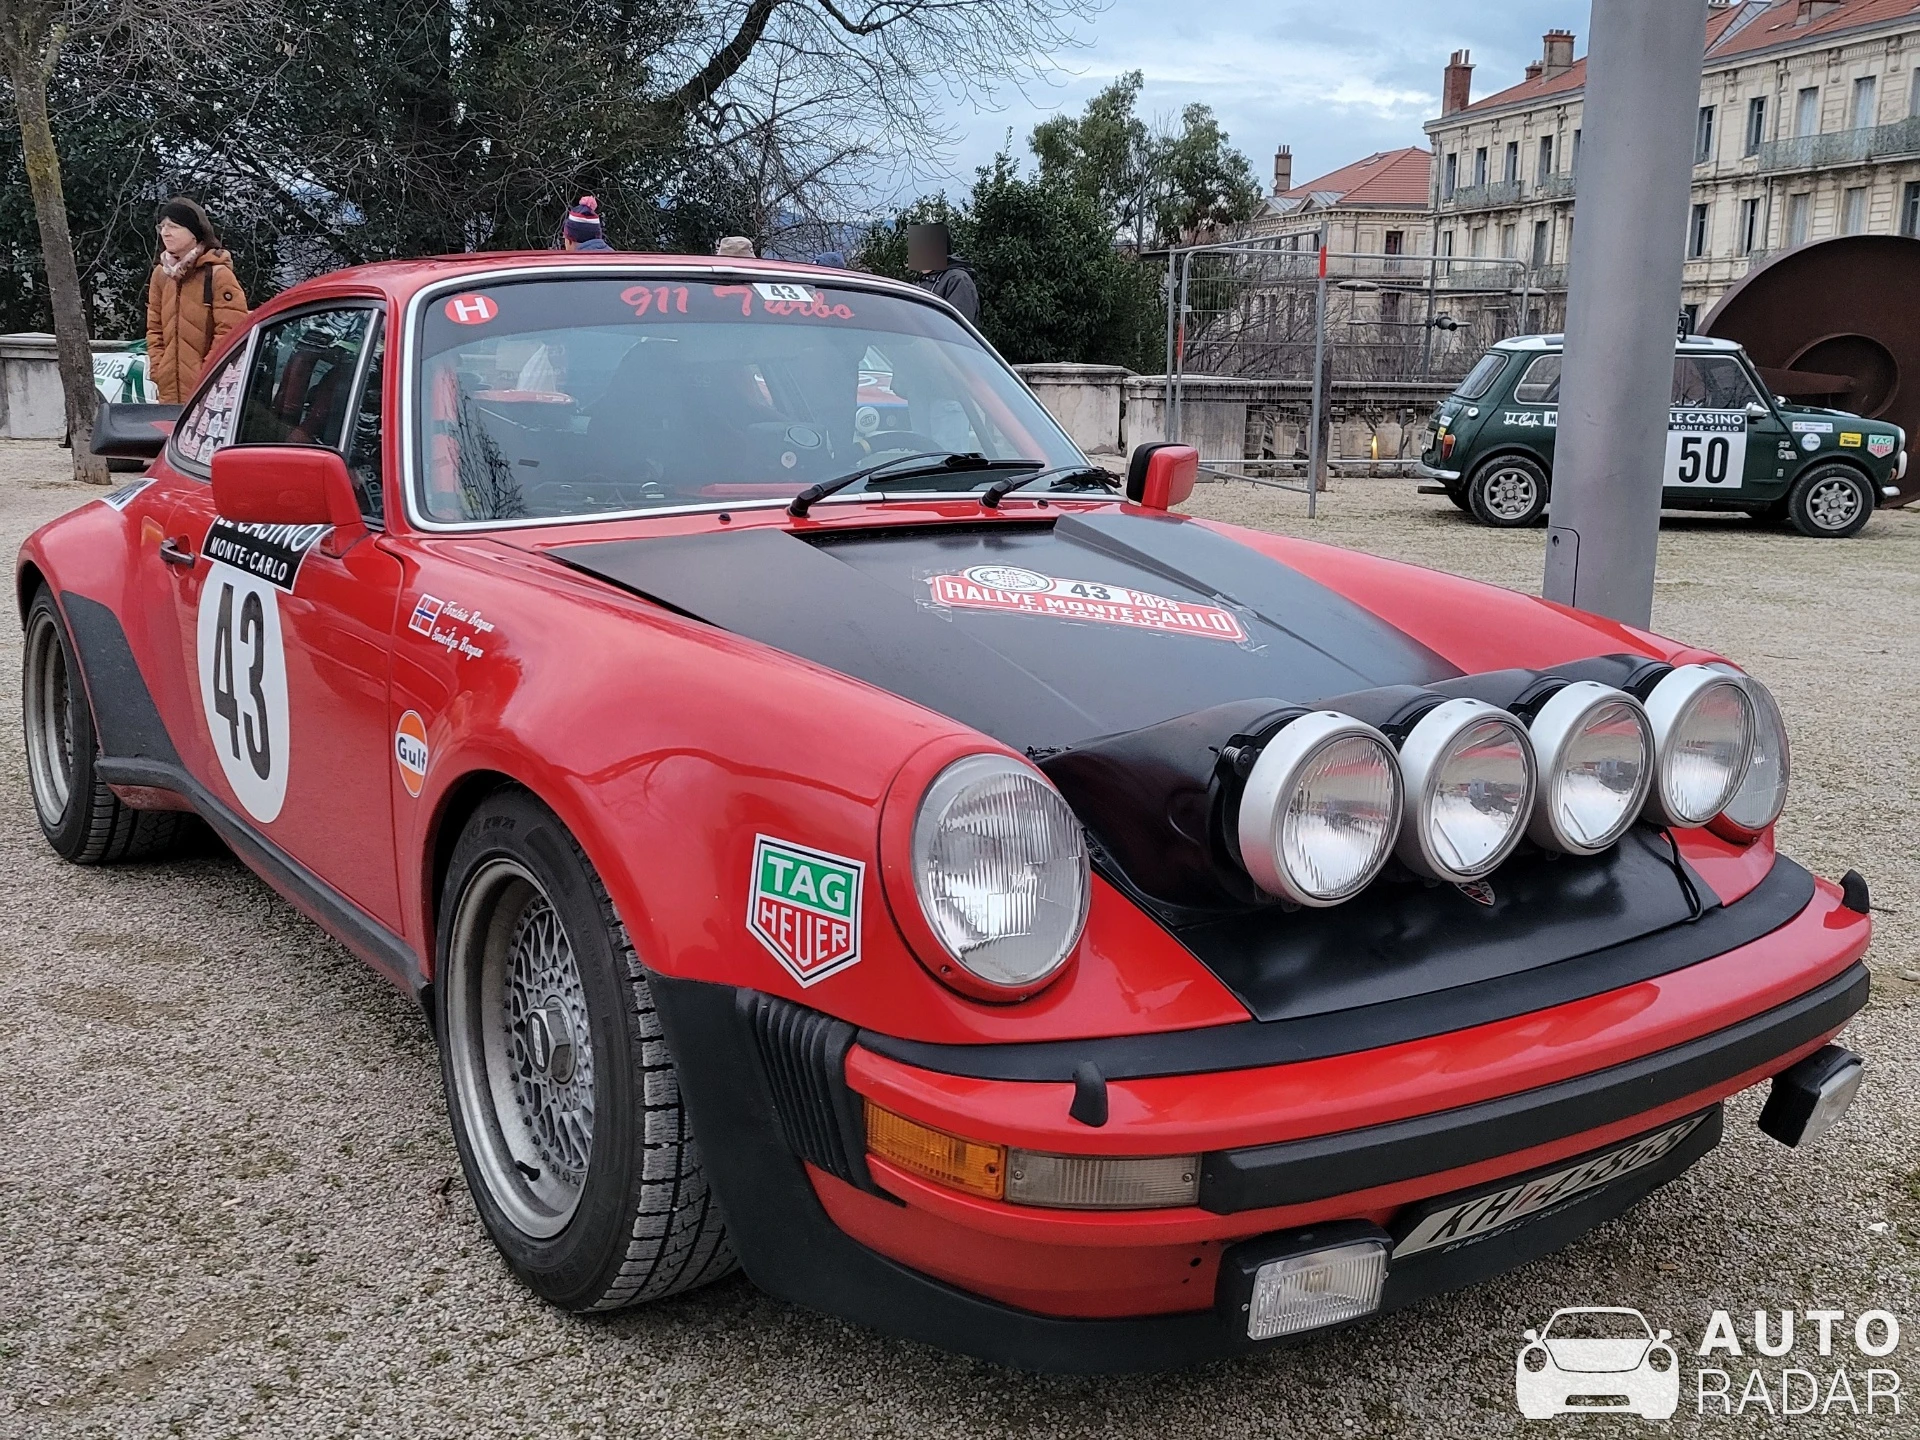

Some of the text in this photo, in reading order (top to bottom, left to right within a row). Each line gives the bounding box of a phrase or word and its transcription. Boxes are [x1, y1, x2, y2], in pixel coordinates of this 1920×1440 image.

[620, 285, 688, 317] 911
[768, 283, 801, 301] 43
[456, 297, 491, 321] H
[1669, 412, 1743, 425] LE CASINO
[1872, 437, 1891, 445] TAG
[1678, 436, 1729, 484] 50
[946, 581, 1231, 632] RALLYE MONTE-CARLO
[1071, 583, 1111, 601] 43
[1131, 591, 1180, 613] 2025
[1019, 604, 1167, 628] HISTORIQUE
[213, 581, 272, 781] 43
[397, 735, 427, 773] Gulf
[771, 855, 848, 909] TAG
[760, 901, 848, 966] HEUER
[1426, 1183, 1527, 1243] KH
